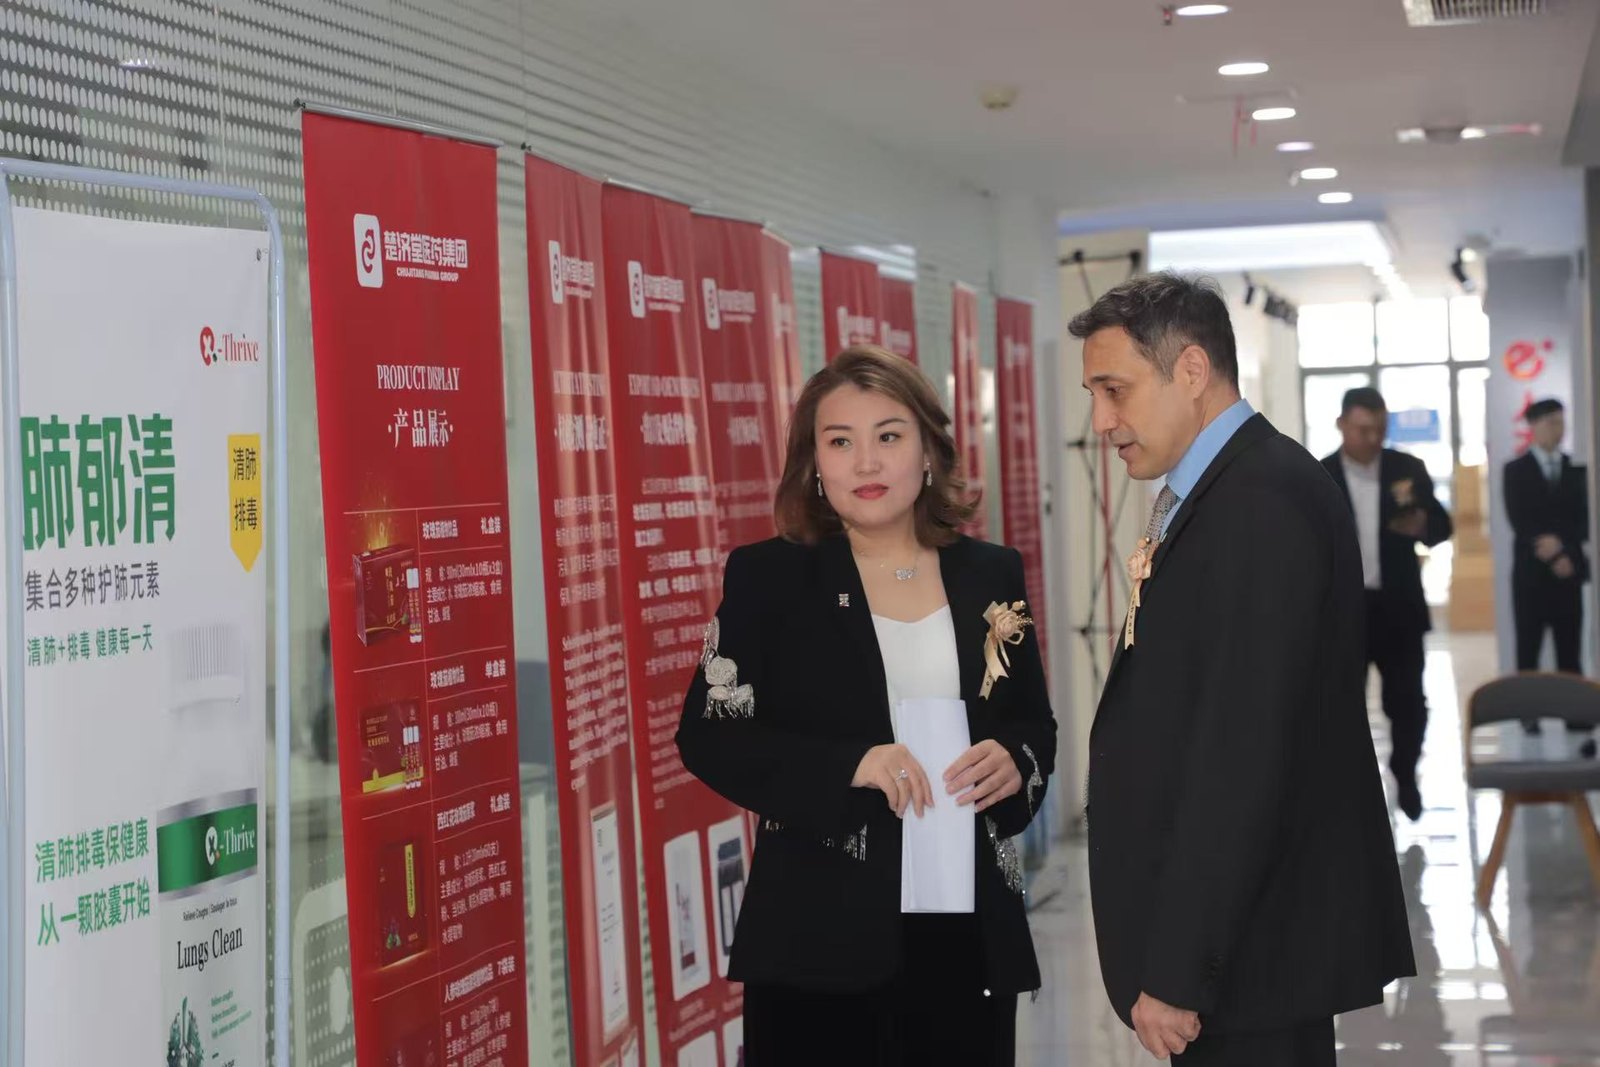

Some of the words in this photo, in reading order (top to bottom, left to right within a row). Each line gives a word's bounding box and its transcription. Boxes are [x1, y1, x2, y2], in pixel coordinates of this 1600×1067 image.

[384, 230, 468, 269] 楚济堂医药集团
[377, 364, 426, 390] PRODUCT
[427, 366, 460, 391] DISPLAY
[20, 413, 176, 551] 肺郁清
[233, 447, 257, 481] 清肺
[235, 497, 258, 531] 排毒
[481, 516, 502, 535] 礼盒装
[25, 560, 161, 612] 集合多种护肺元素
[95, 624, 153, 658] 健康每一天
[35, 816, 150, 883] 清肺排毒保健康
[37, 877, 151, 946] 从一颗胶囊开始
[177, 941, 209, 972] Lungs
[212, 927, 243, 959] Clean
